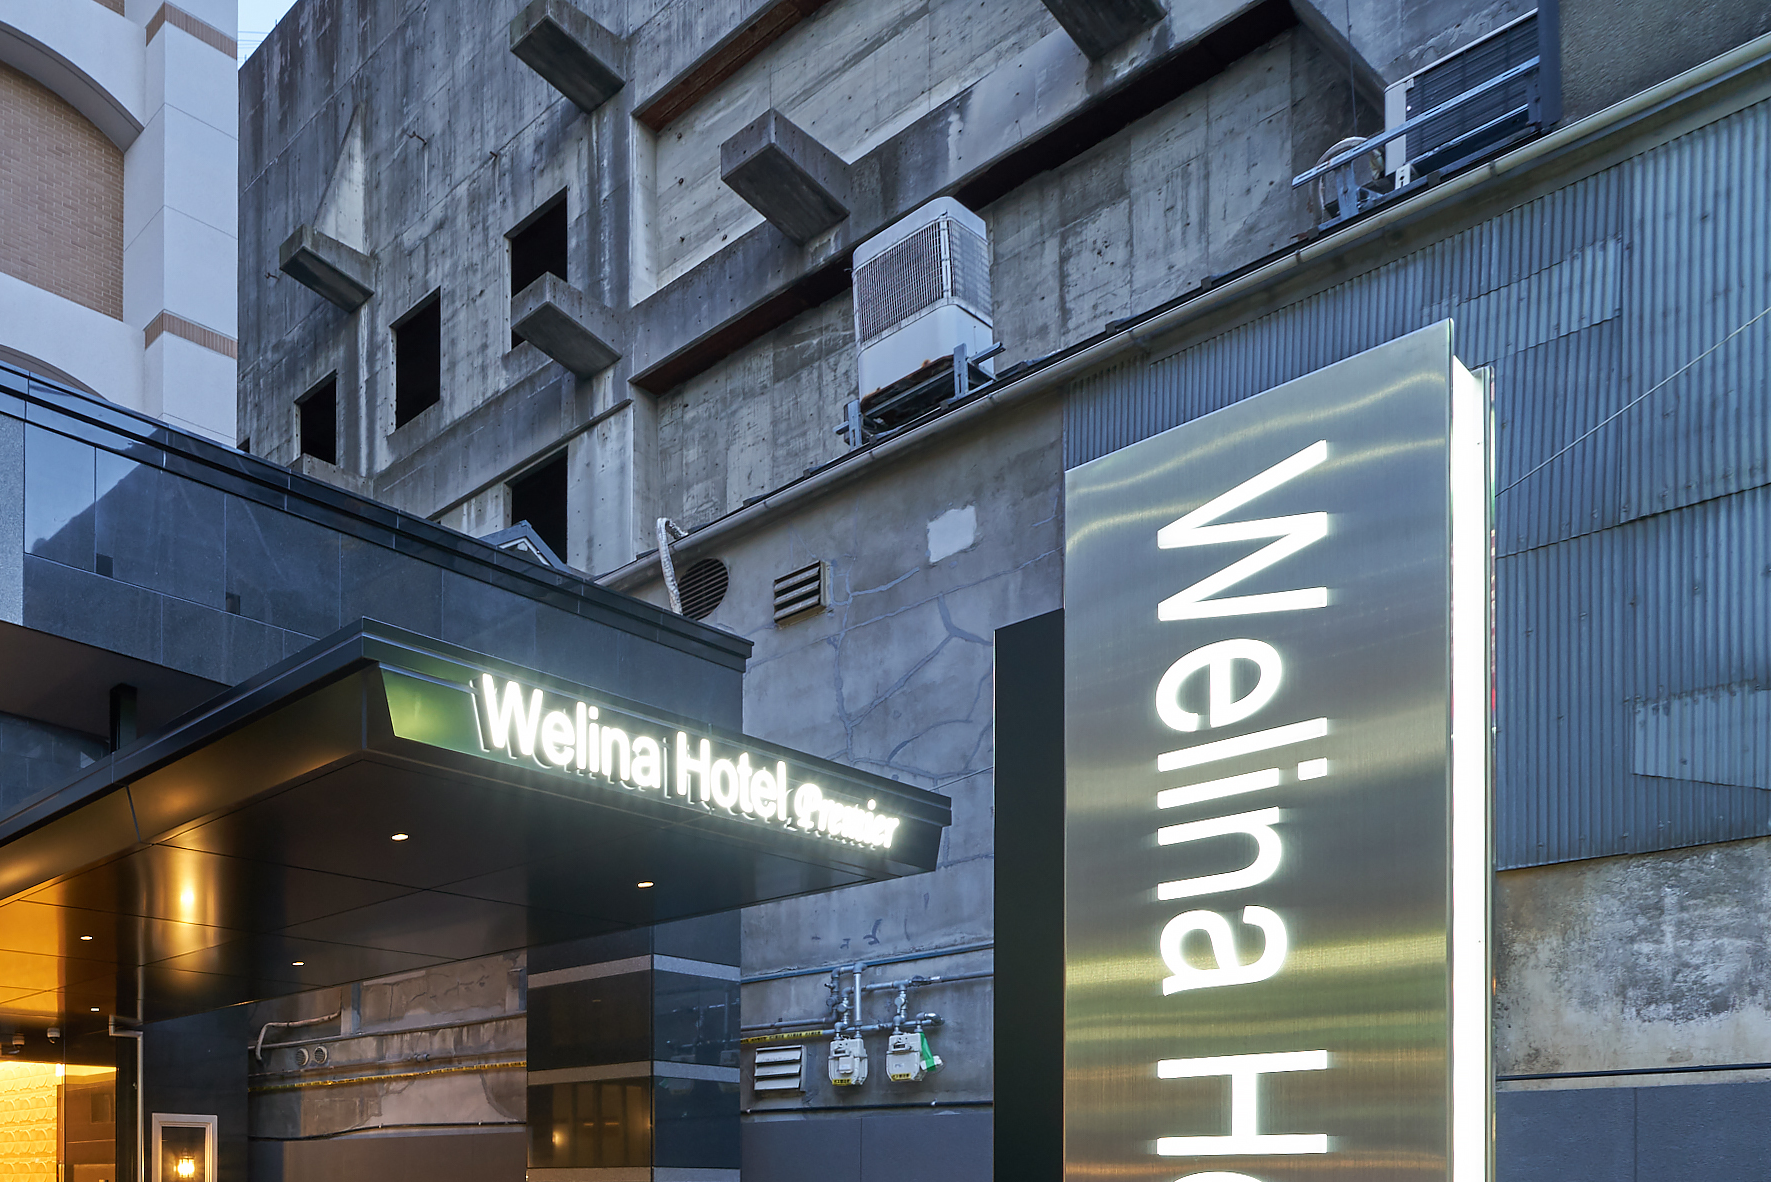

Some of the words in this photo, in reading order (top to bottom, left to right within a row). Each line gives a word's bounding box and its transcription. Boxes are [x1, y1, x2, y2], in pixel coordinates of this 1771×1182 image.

[477, 673, 662, 789] Welina
[675, 731, 788, 822] Hotel
[794, 782, 901, 849] Premier
[1154, 439, 1328, 996] Welina
